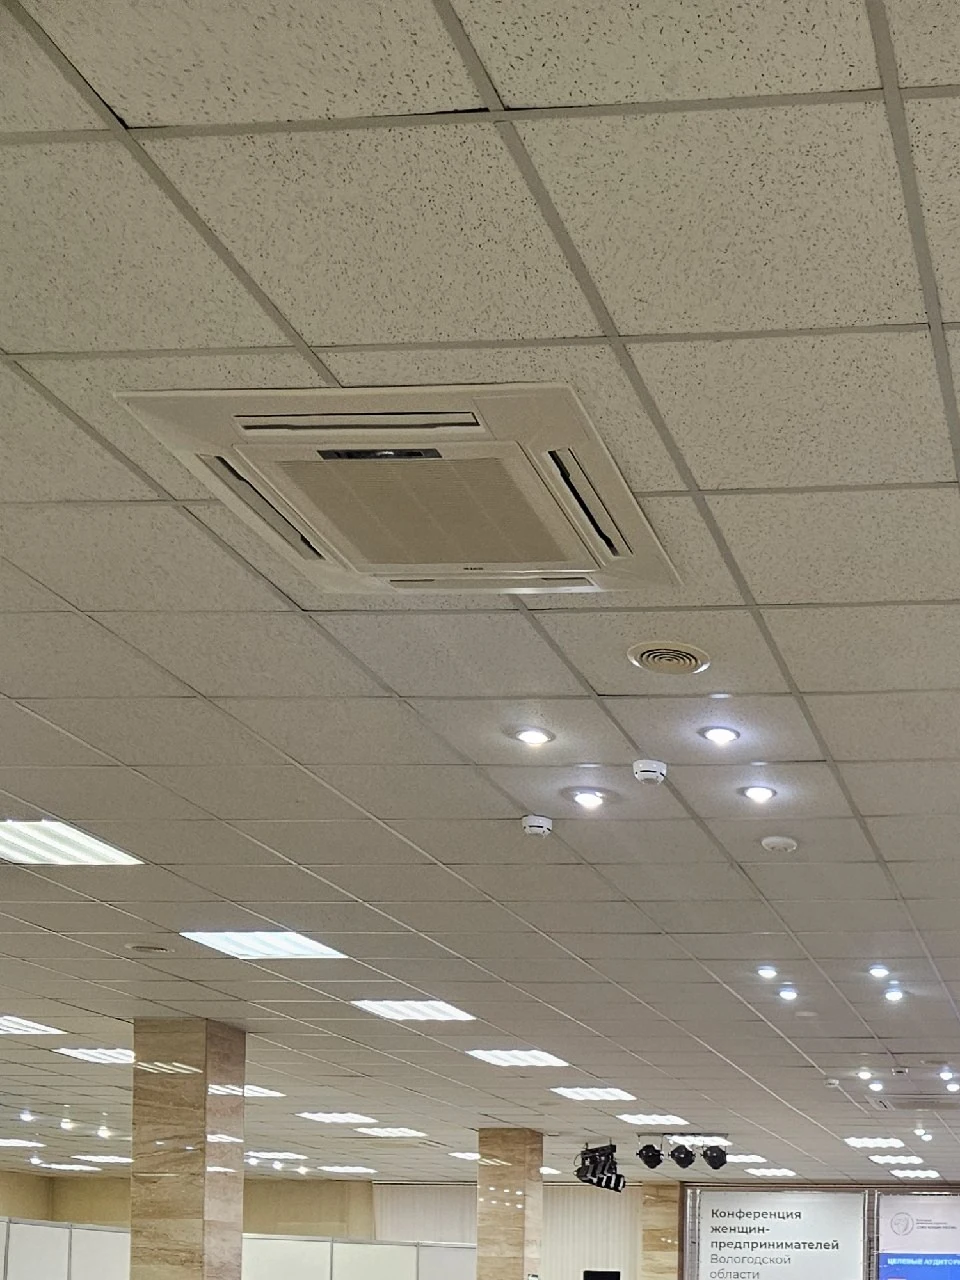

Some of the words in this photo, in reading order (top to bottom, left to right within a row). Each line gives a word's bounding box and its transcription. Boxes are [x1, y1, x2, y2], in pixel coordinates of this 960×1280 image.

[711, 1209, 802, 1220] Конференция
[710, 1225, 770, 1234] женщин-
[710, 1240, 840, 1251] предпринимателей
[710, 1254, 791, 1265] Вологодской
[709, 1268, 760, 1279] области
